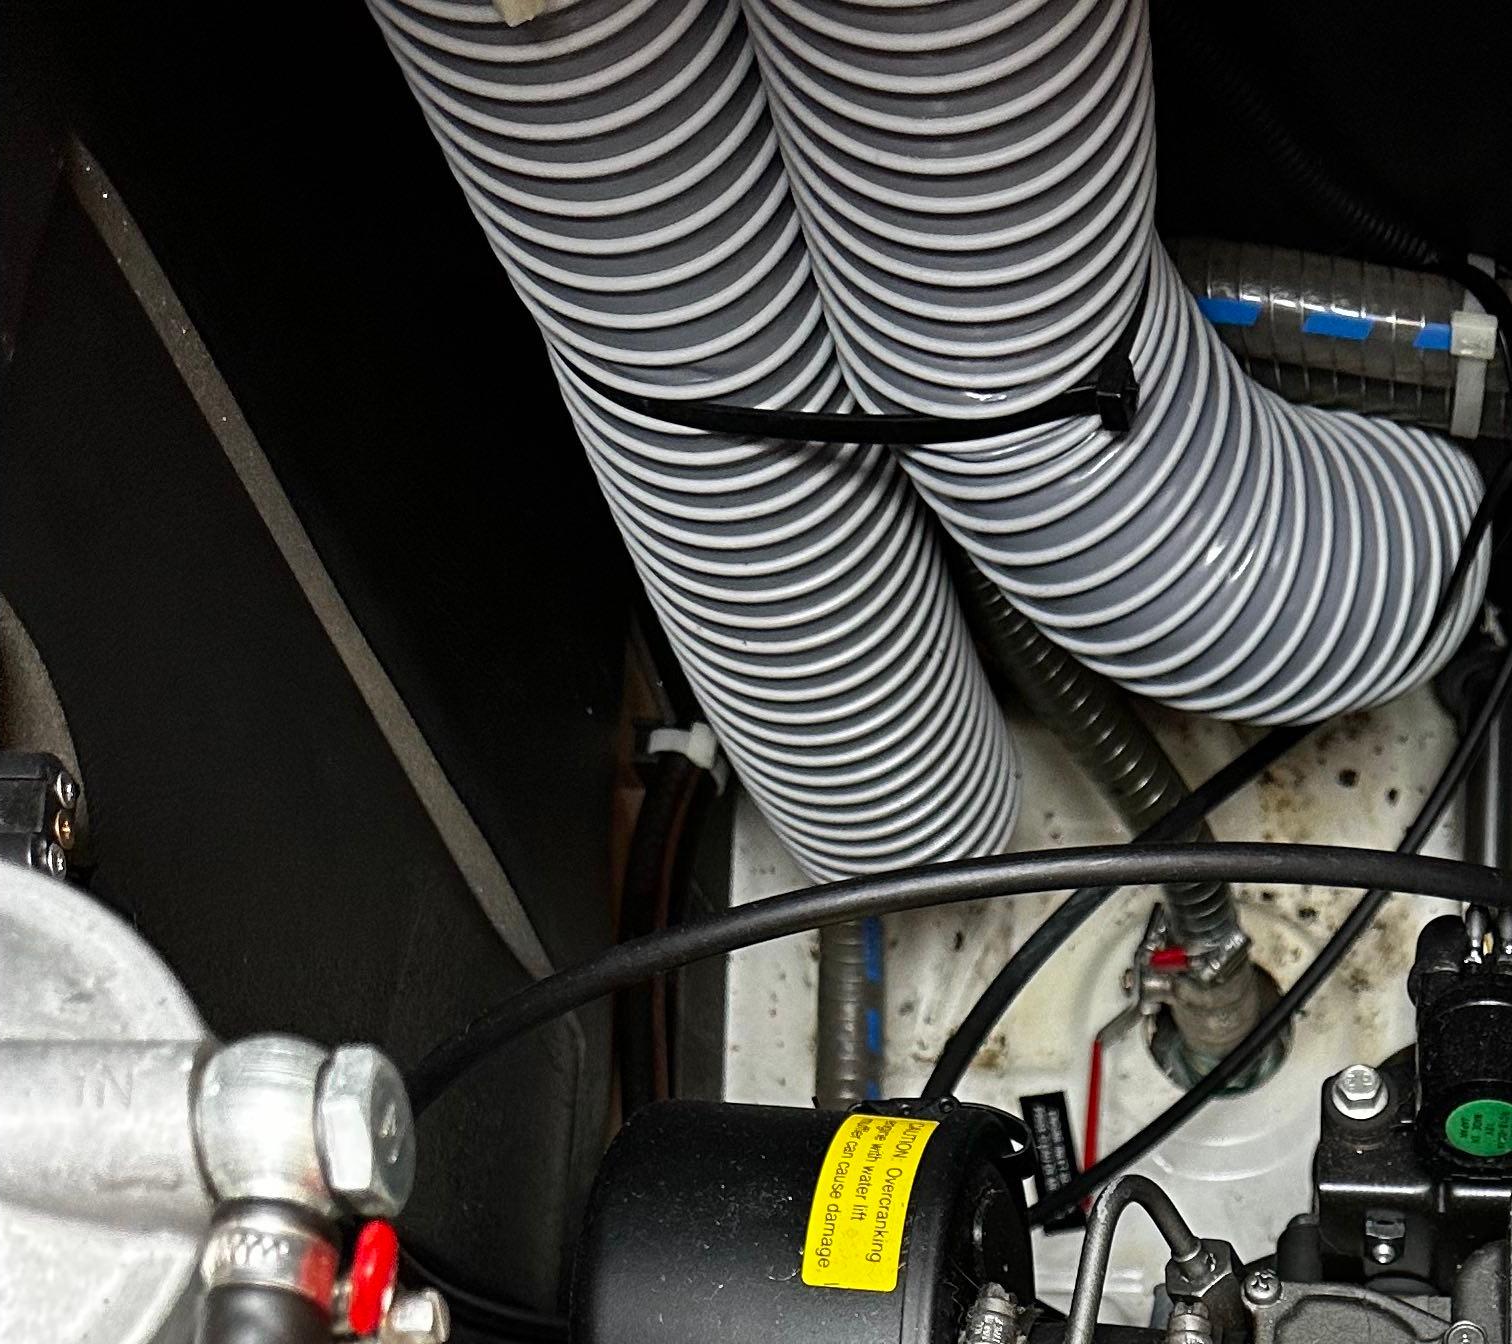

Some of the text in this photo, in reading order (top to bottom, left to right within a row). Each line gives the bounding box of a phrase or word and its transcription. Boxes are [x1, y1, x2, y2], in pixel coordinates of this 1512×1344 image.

[866, 1144, 884, 1162] with
[830, 1141, 858, 1199] can cause
[855, 1166, 875, 1199] water
[851, 1205, 868, 1221] lift
[866, 1168, 902, 1263] Overcranking
